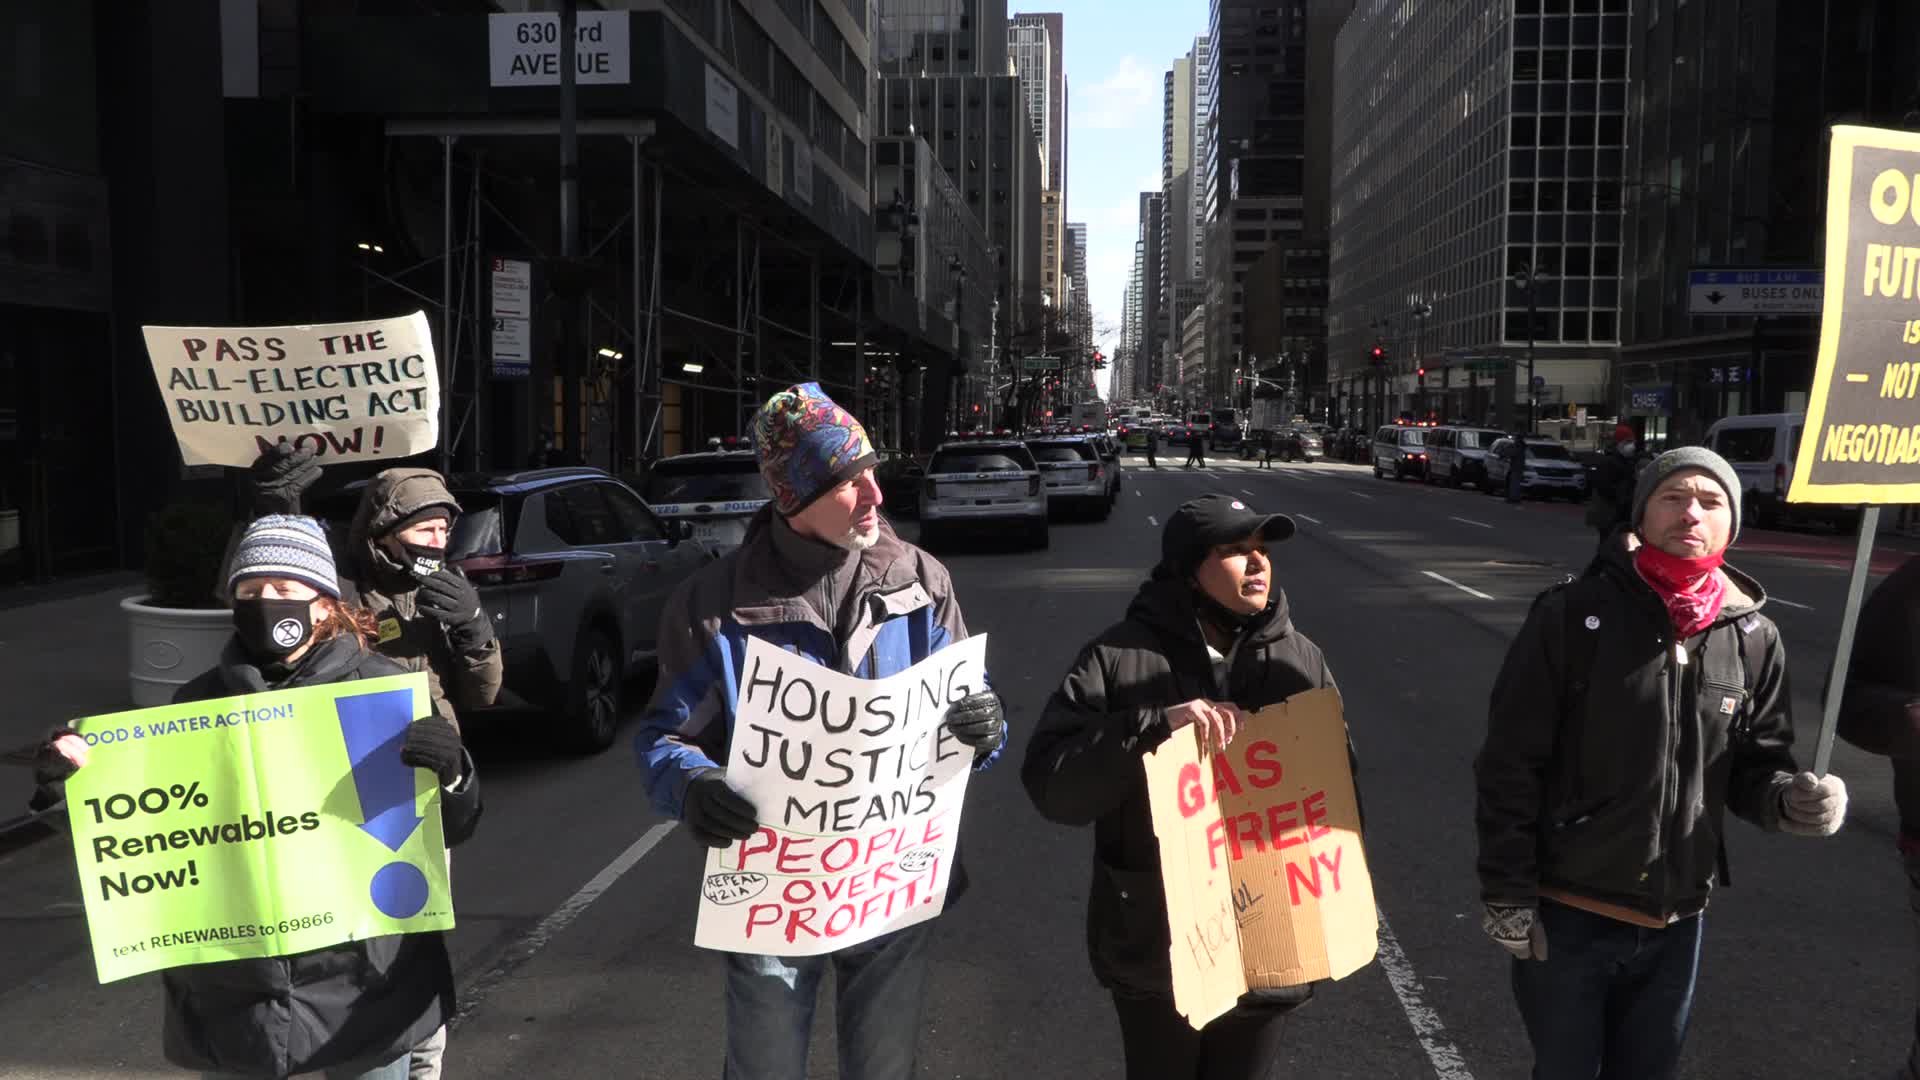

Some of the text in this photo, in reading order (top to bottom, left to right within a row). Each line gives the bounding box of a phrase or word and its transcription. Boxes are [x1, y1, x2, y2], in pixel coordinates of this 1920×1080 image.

[517, 21, 602, 43] 630 rd
[510, 53, 610, 75] AVEUE
[1742, 287, 1823, 299] BUSES ONL
[1864, 243, 1920, 300] FUT
[182, 329, 388, 362] PASS THE
[1903, 319, 1920, 345] IS
[168, 353, 425, 394] ALL-ELECTRIC
[1880, 361, 1920, 399] NOT
[175, 386, 427, 427] BUILDING ACT
[651, 505, 679, 515] YPD
[747, 655, 971, 737] HOUSING
[83, 703, 294, 746] OOD & WATER ACTION!
[742, 720, 960, 788] JUSTICE
[1178, 740, 1283, 819] GAS
[84, 781, 209, 824] 100%
[784, 775, 936, 832] MEANS
[92, 811, 320, 863] Renewables
[736, 808, 951, 873] PEOPLE
[1205, 790, 1331, 870] FREE
[99, 860, 200, 901] Now!
[706, 874, 764, 889] REPEAL
[782, 861, 899, 904] OVER
[1285, 844, 1342, 906] NY
[746, 857, 939, 944] PROFIT!
[112, 911, 334, 958] text RENEWABLES to 69866
